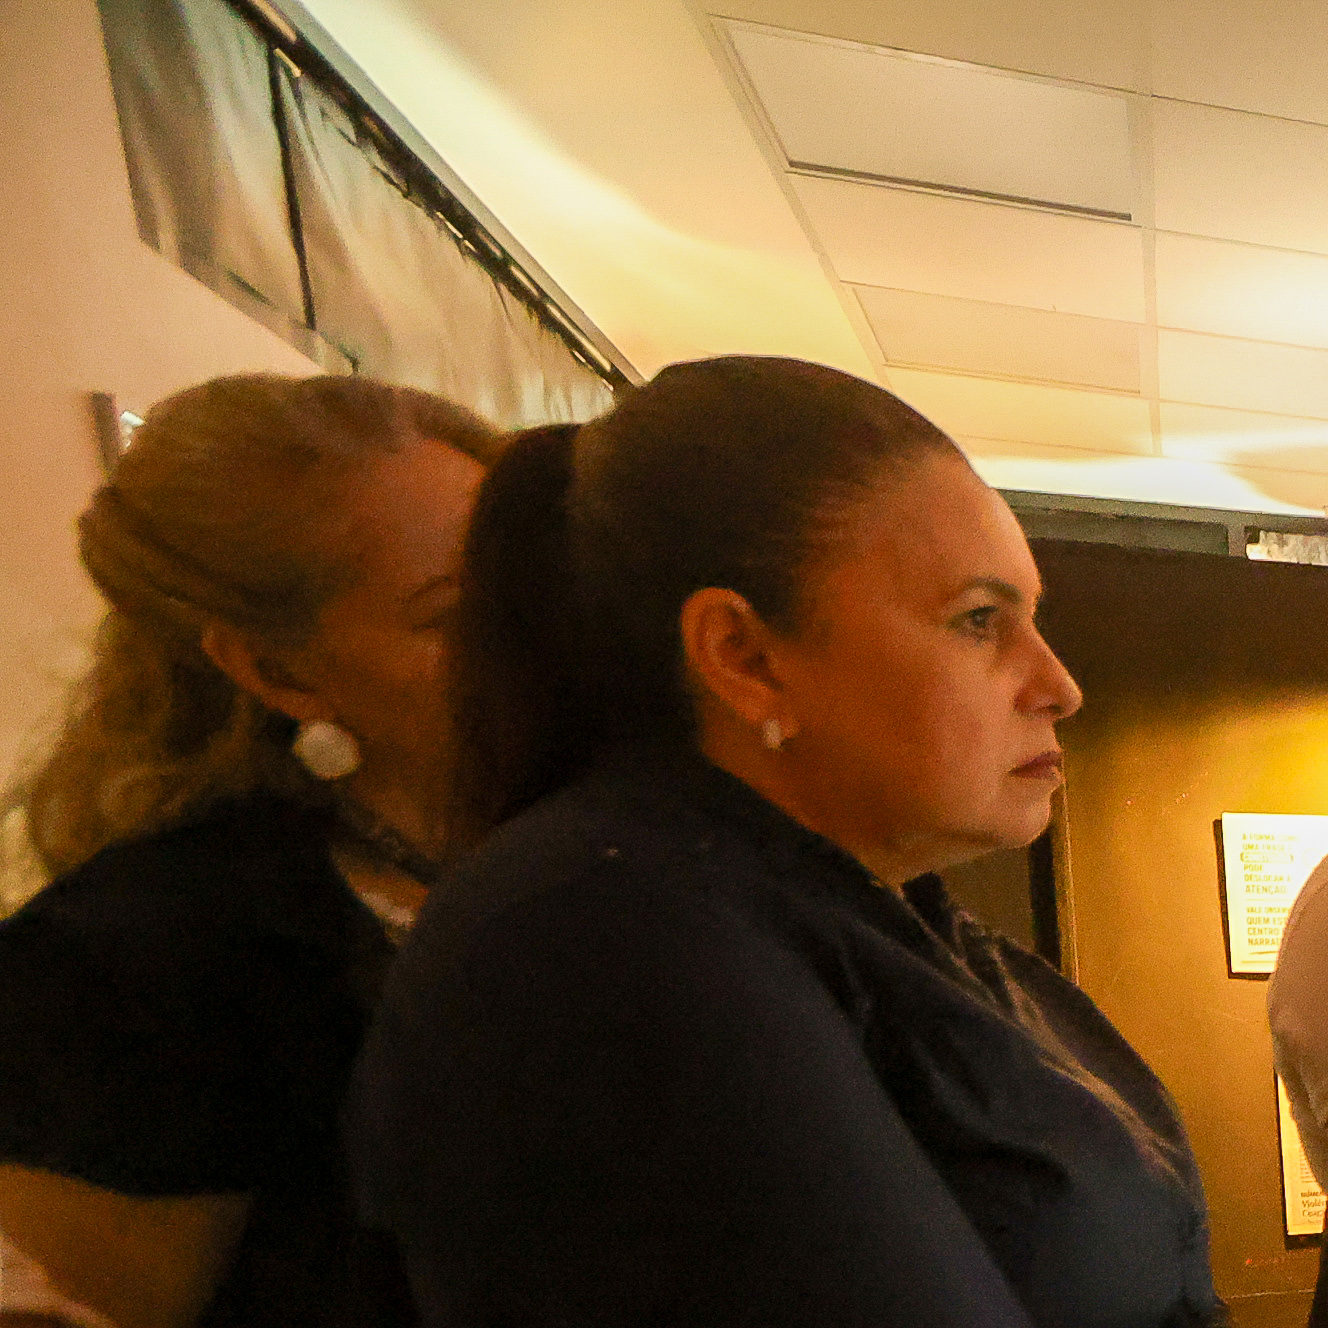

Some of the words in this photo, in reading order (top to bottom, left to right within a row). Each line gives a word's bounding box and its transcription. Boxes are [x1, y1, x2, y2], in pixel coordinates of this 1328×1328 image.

[1246, 916, 1270, 925] QUEM
[1247, 927, 1280, 936] CENTRO
[1248, 938, 1279, 946] NARRAT
